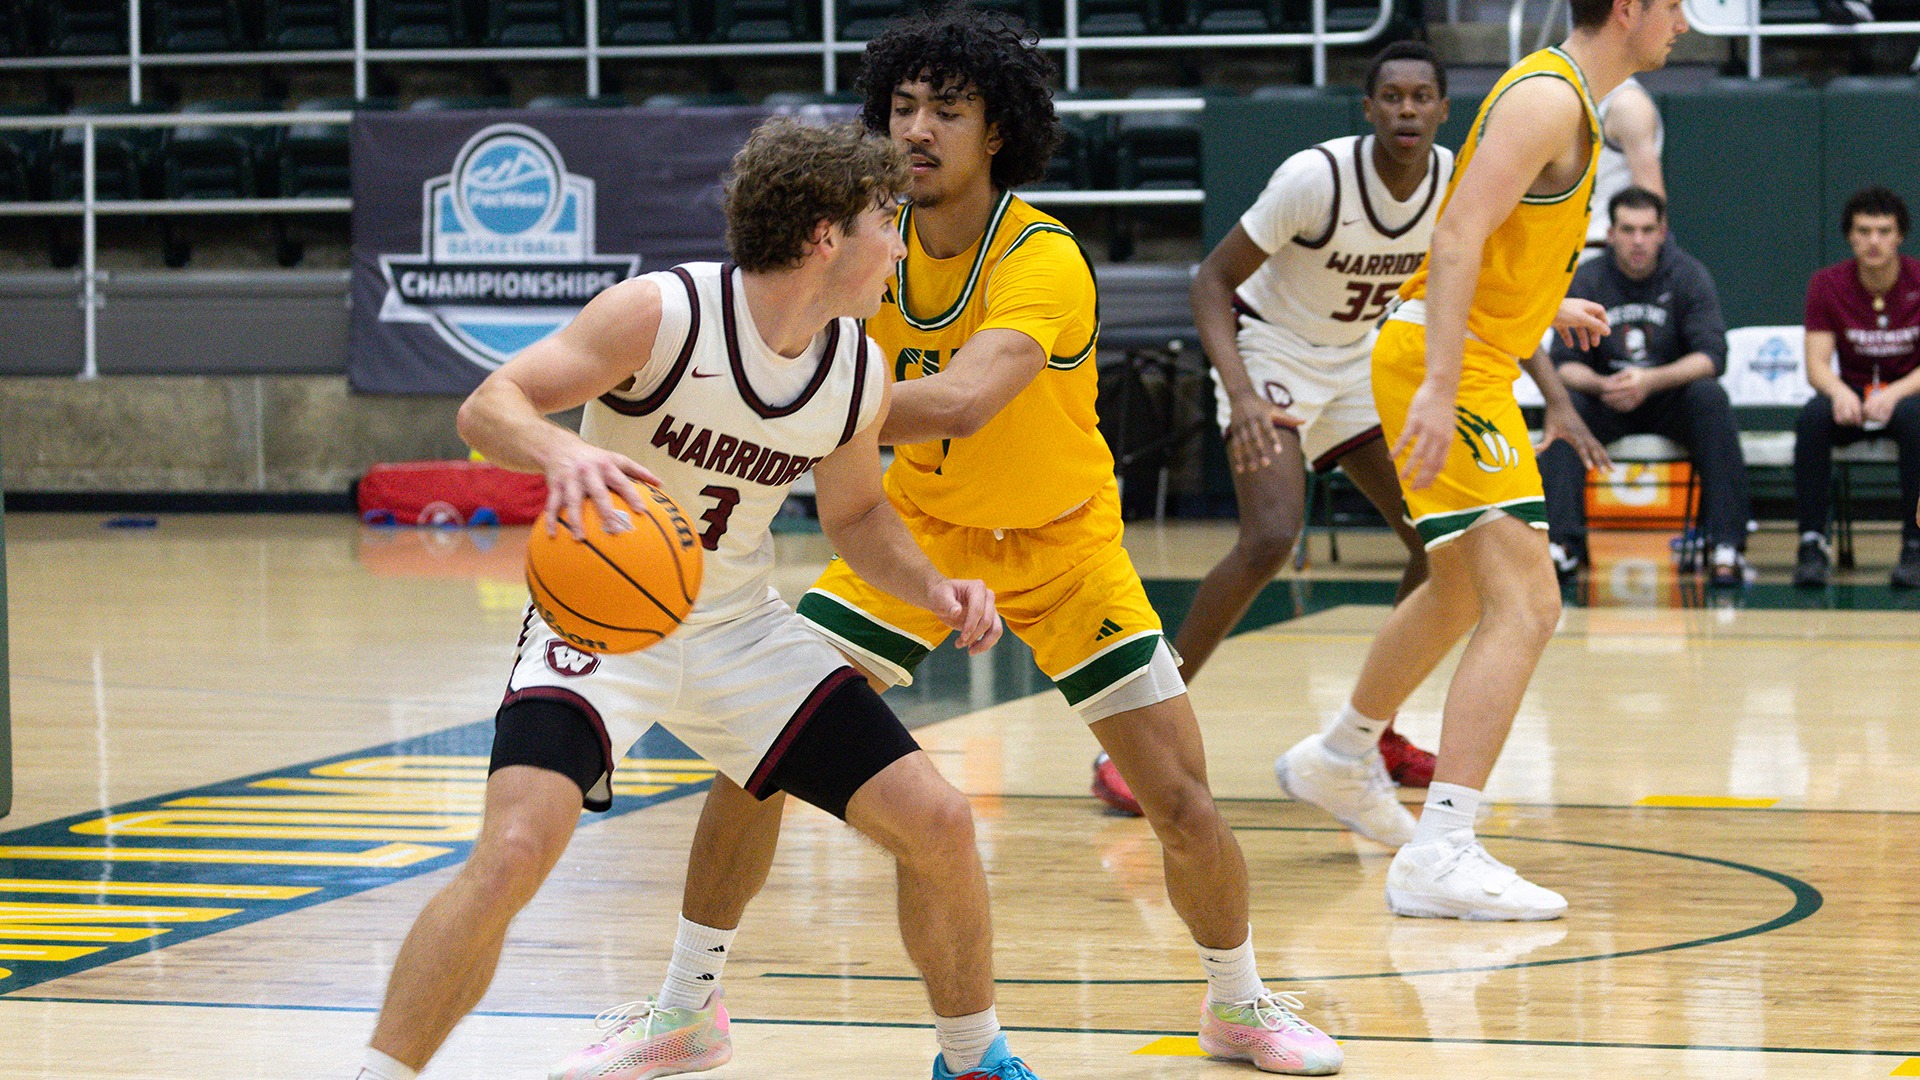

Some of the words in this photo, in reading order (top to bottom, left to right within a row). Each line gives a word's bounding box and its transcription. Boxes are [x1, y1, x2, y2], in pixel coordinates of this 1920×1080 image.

[447, 239, 569, 255] BASKETBALL
[1326, 251, 1427, 275] WARRIOR
[1330, 281, 1404, 323] 35
[699, 484, 740, 551] 3
[552, 645, 594, 674] W
